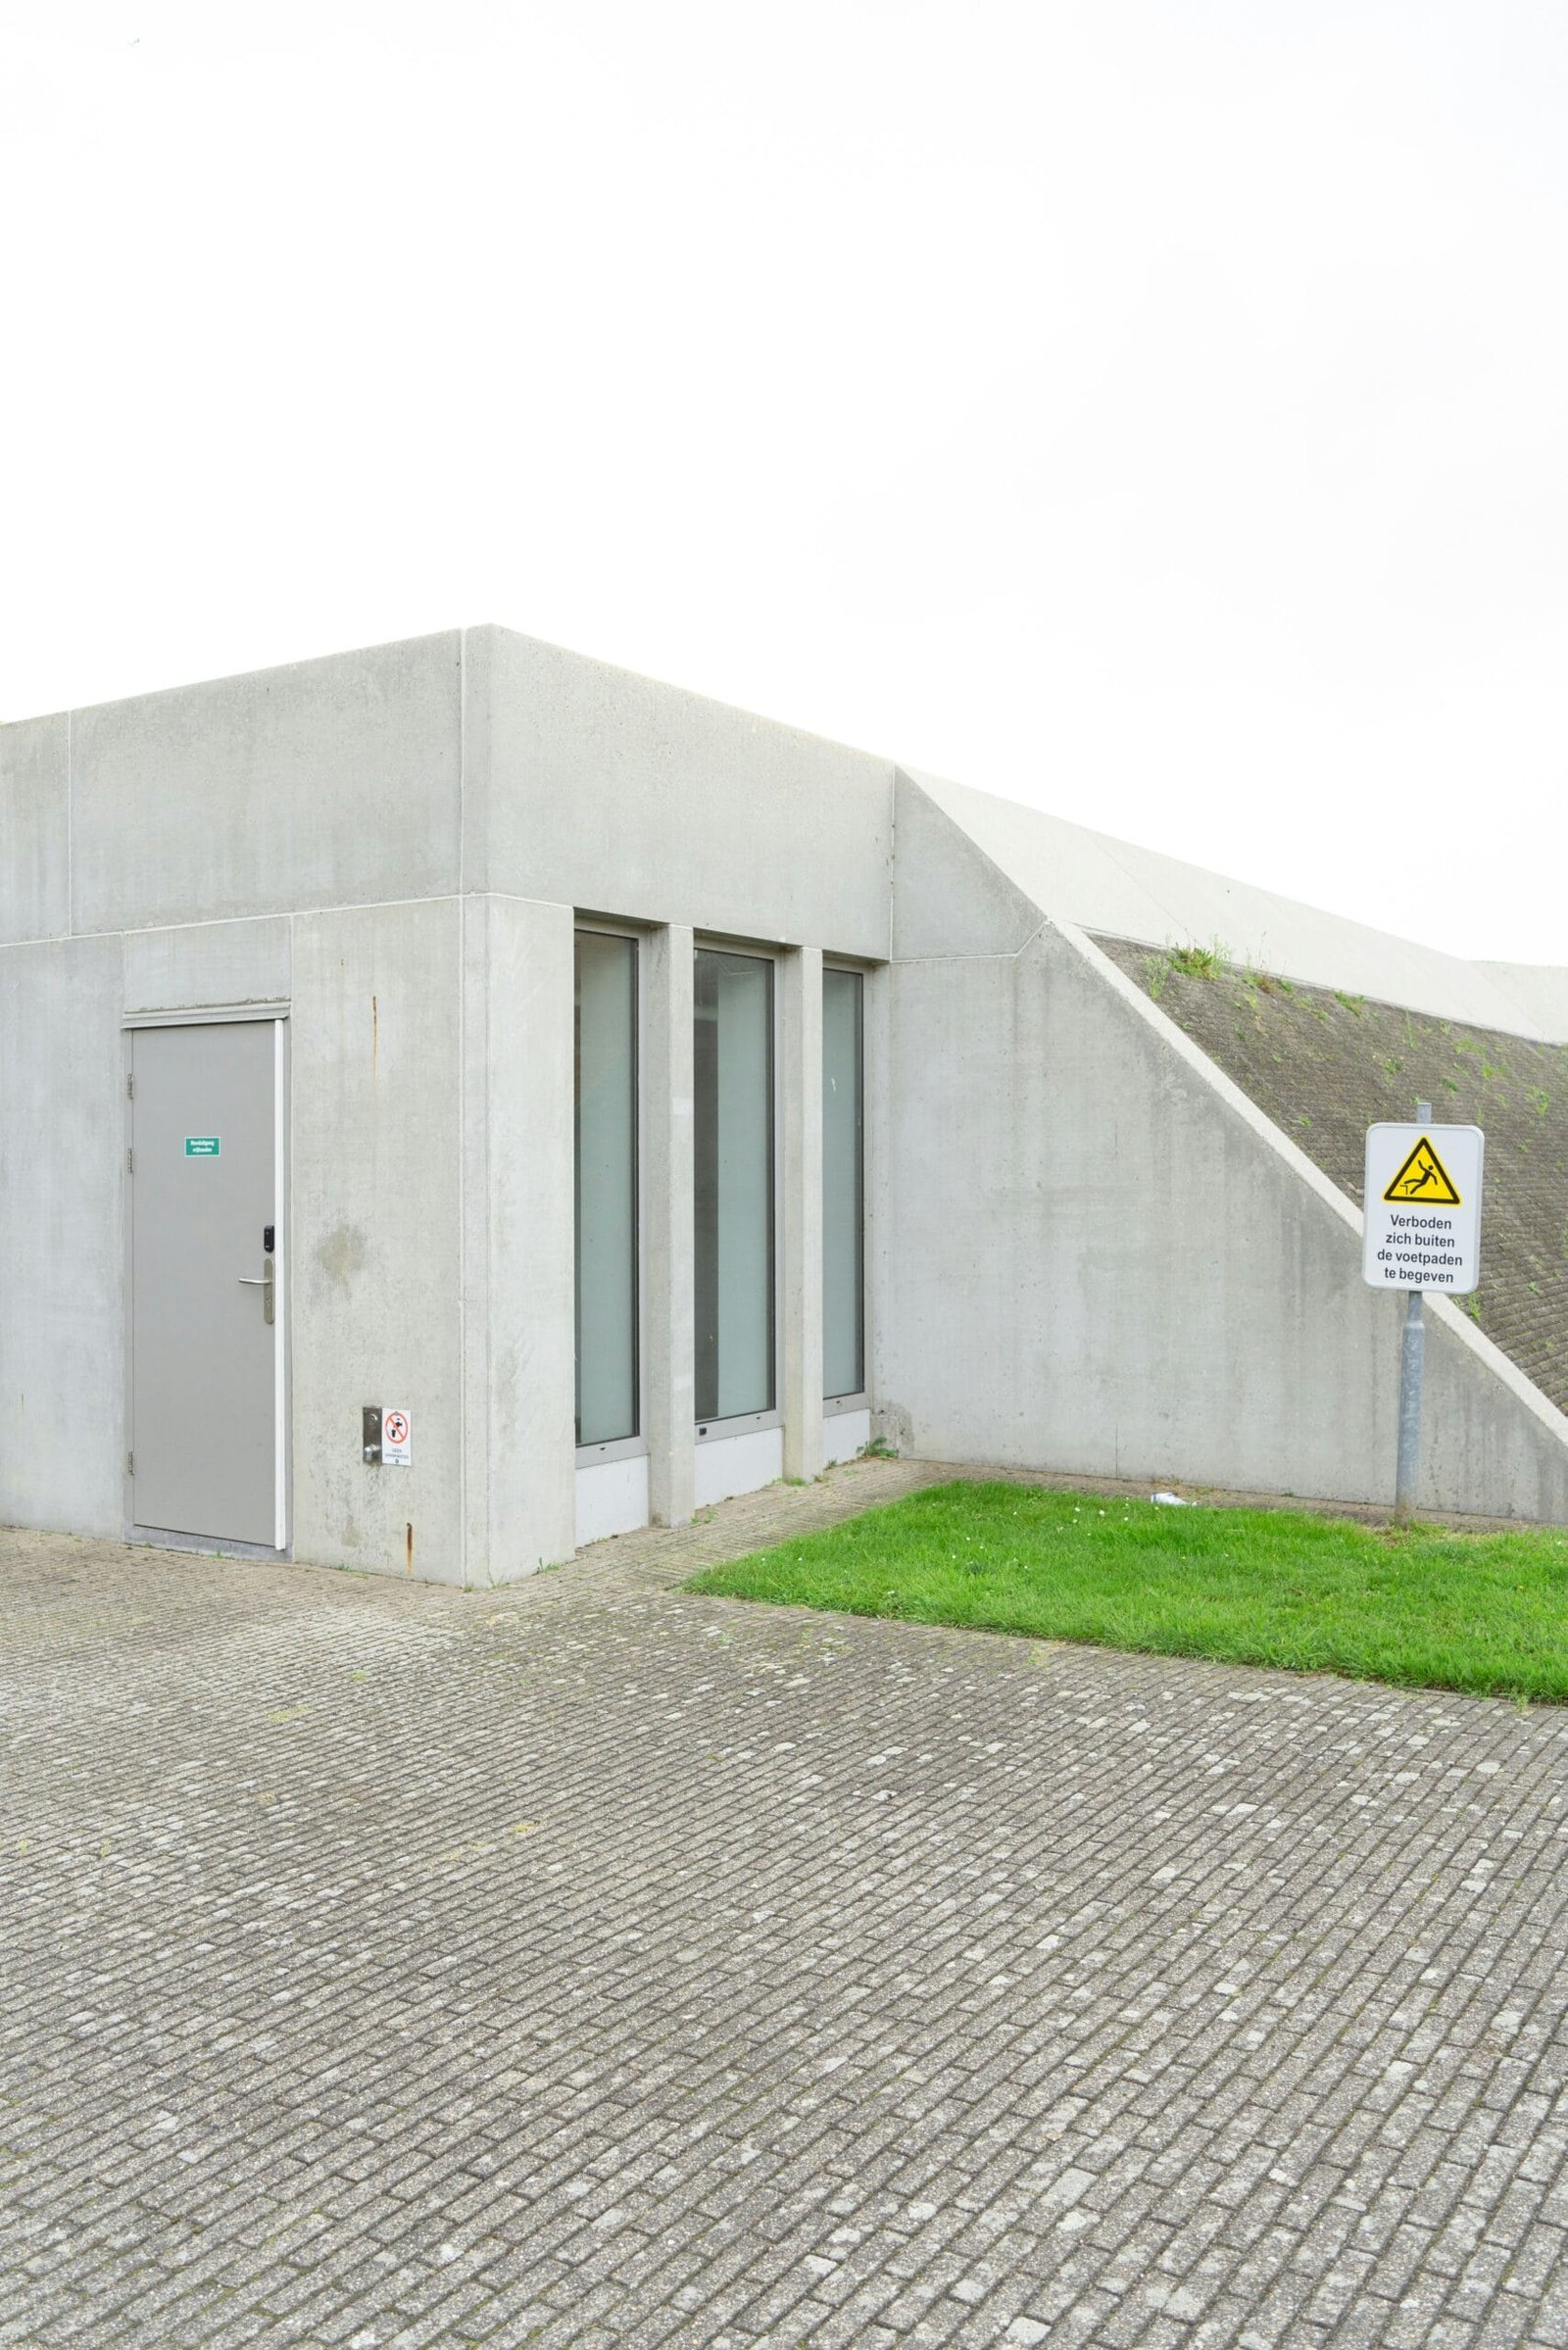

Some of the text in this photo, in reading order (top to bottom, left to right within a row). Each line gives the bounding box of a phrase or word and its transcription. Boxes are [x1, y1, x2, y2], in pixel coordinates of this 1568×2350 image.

[1390, 1214, 1452, 1230] Verboden
[1385, 1232, 1455, 1248] zich buiten
[1377, 1248, 1463, 1266] de voetpaden
[1384, 1267, 1454, 1284] te begeven
